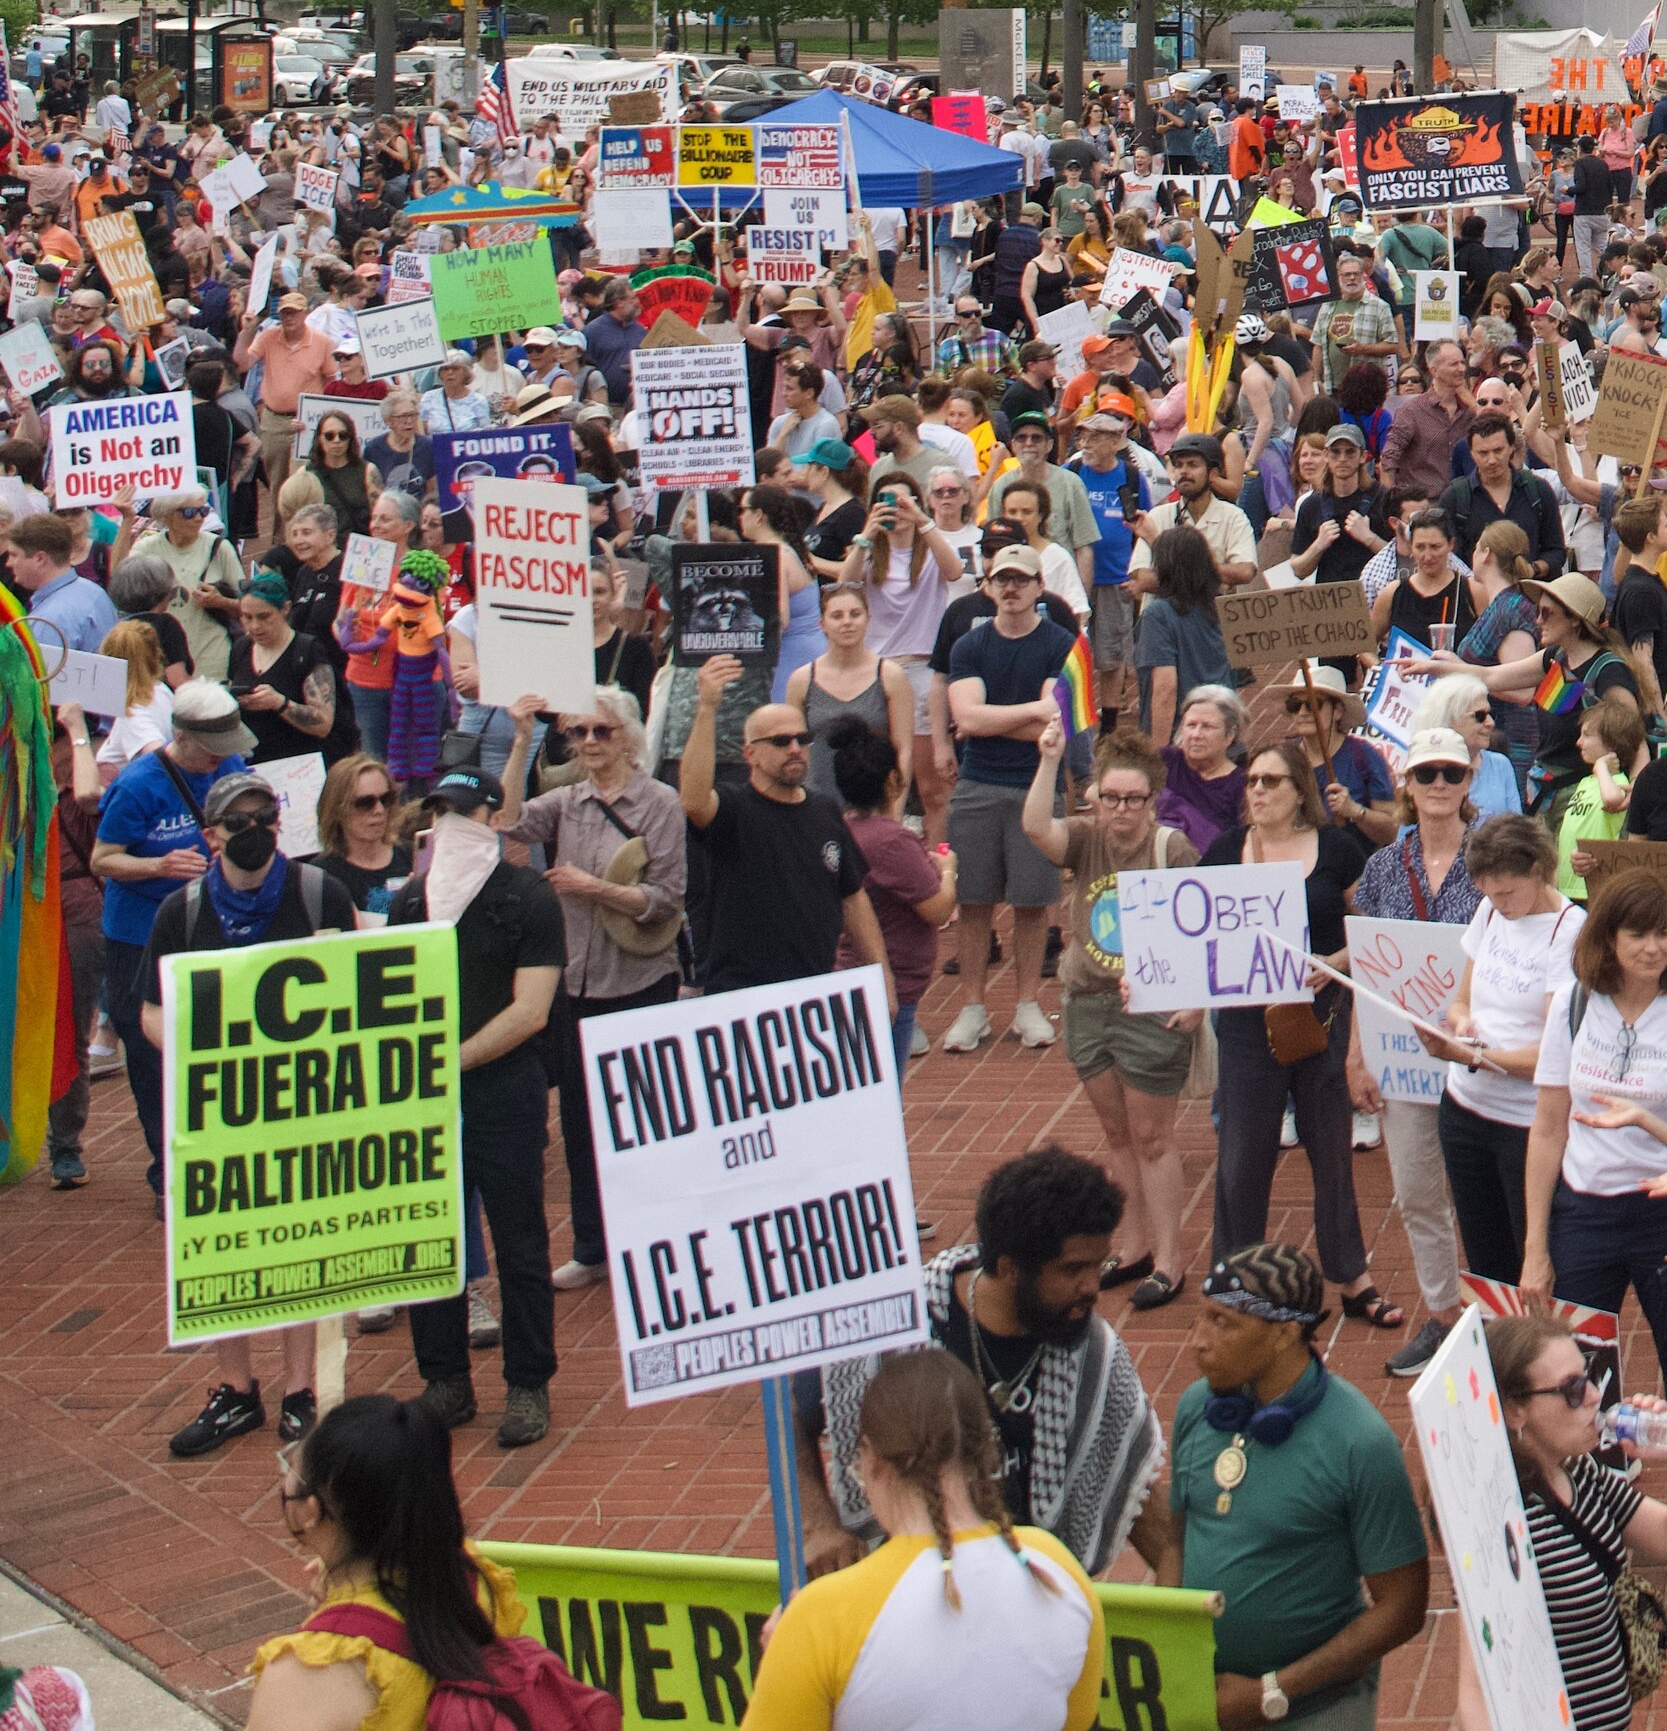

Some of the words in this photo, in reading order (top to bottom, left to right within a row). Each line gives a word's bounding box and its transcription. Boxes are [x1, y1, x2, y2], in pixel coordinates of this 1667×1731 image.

[521, 80, 548, 91] END
[573, 80, 639, 92] MILITARY
[643, 77, 667, 91] AID
[1284, 99, 1308, 109] MORAL
[1417, 117, 1454, 128] TRUTH
[606, 140, 637, 154] HELP
[683, 133, 712, 146] STOP
[724, 133, 747, 146] THE
[301, 167, 333, 189] DOGE
[701, 166, 732, 179] COUP
[1367, 171, 1397, 185] ONLY
[1401, 169, 1426, 182] YOU
[1455, 164, 1506, 178] PREVENT
[1370, 181, 1451, 203] FASCIST
[1456, 175, 1510, 195] LIARS
[83, 214, 137, 250] BRING
[751, 229, 815, 250] RESIST
[488, 243, 535, 263] MANY
[753, 261, 816, 282] TRUMP
[116, 281, 165, 330] HOME
[469, 314, 527, 335] STOPPED
[371, 336, 435, 360] Together!
[651, 387, 733, 409] HANDS
[65, 399, 179, 434] AMERICA
[653, 406, 735, 439] OFF!
[70, 443, 92, 465] is
[101, 436, 143, 462] Not
[151, 436, 180, 456] an
[452, 436, 524, 457] FOUND
[65, 463, 183, 498] Oligarchy
[485, 504, 582, 545] REJECT
[480, 552, 588, 598] FASCISM
[680, 561, 766, 578] BECOME
[1224, 594, 1279, 621] STOP
[1233, 630, 1281, 654] STOP
[1287, 626, 1312, 647] THE
[1315, 619, 1368, 643] CHAOS
[1135, 946, 1176, 986] the
[1355, 933, 1403, 989] NO
[189, 945, 445, 1050] I.C.E.
[186, 1040, 370, 1132] FUERA
[378, 1031, 448, 1105] DE
[597, 1036, 696, 1152] END
[695, 987, 884, 1128] RACISM
[723, 1121, 775, 1170] and
[184, 1126, 447, 1217] BALTIMORE
[215, 1230, 248, 1252] DE
[256, 1214, 339, 1245] TODAS
[345, 1199, 448, 1233] PARTES!
[731, 1177, 908, 1307] TERROR!
[259, 1261, 318, 1294] POWER
